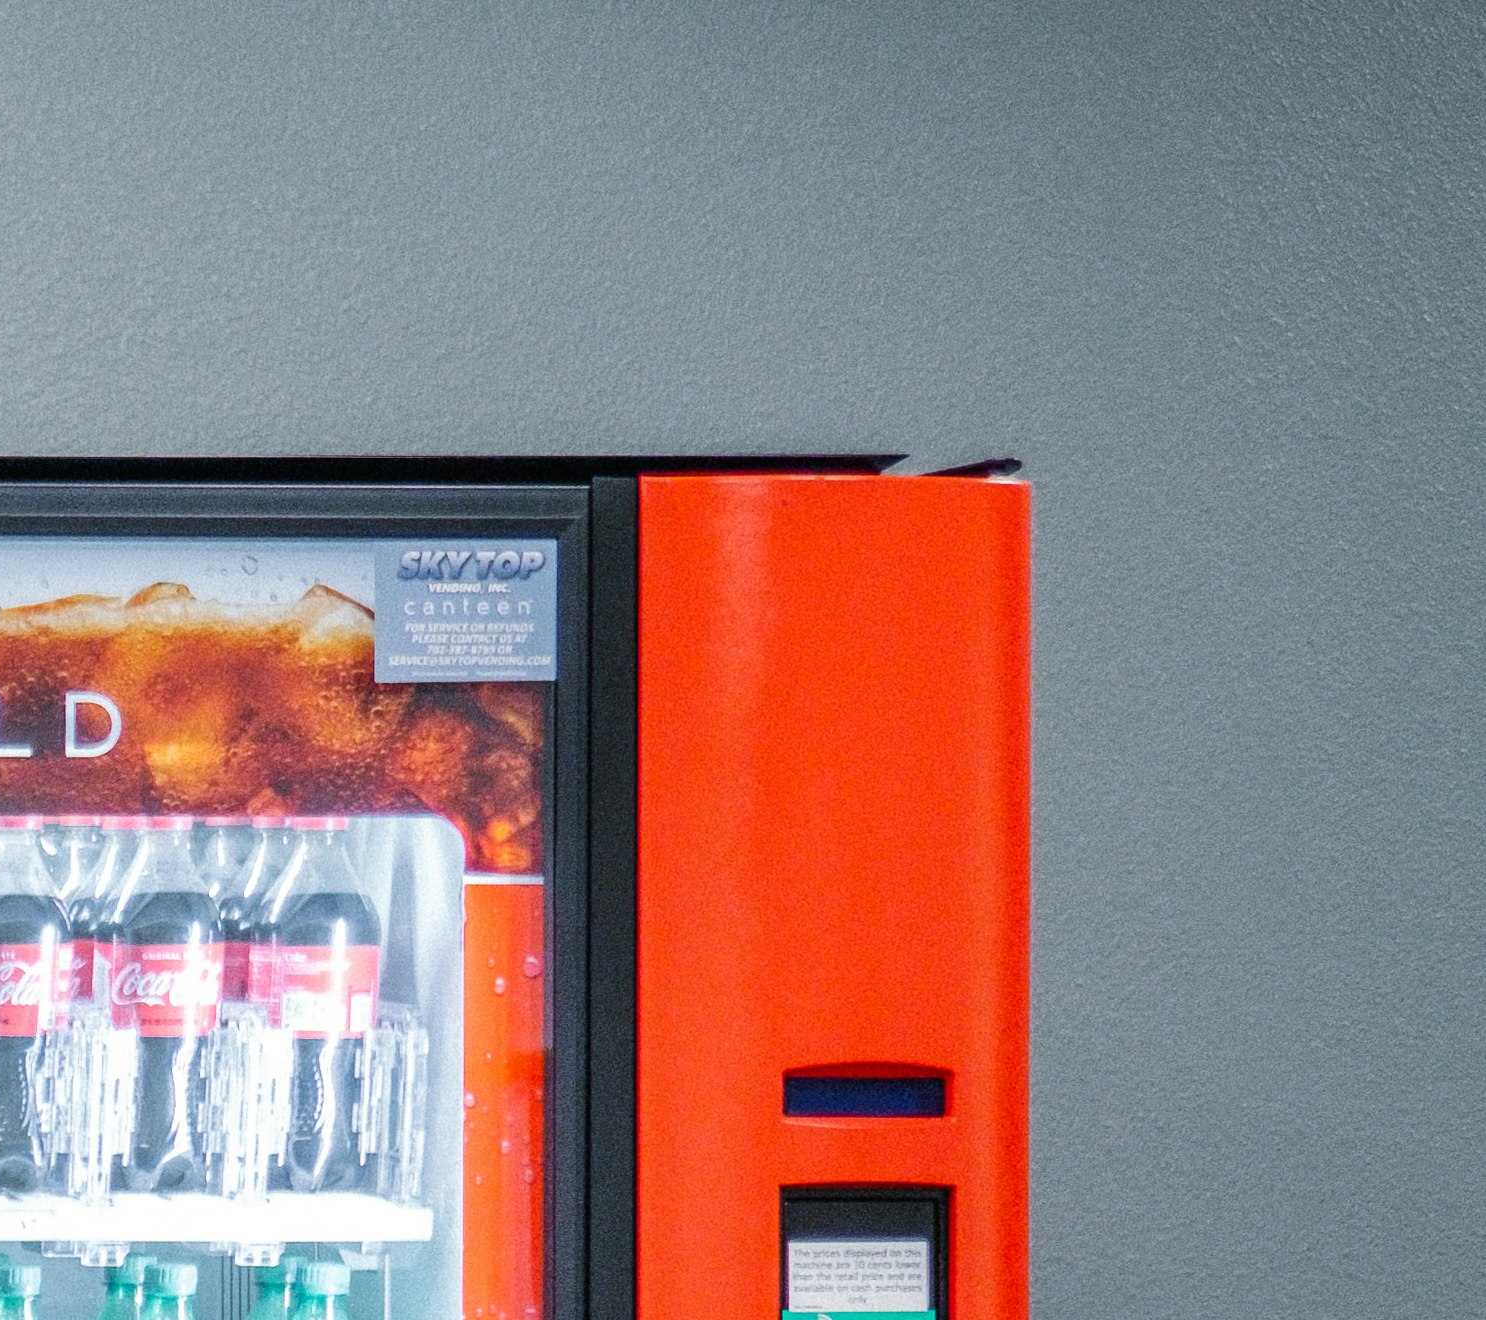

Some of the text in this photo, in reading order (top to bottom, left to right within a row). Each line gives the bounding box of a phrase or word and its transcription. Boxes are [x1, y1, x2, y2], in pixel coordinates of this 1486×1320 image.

[396, 550, 545, 581] SKY TOP
[403, 597, 532, 616] canteen
[427, 623, 468, 633] SERVICE
[450, 634, 498, 644] CONTACT
